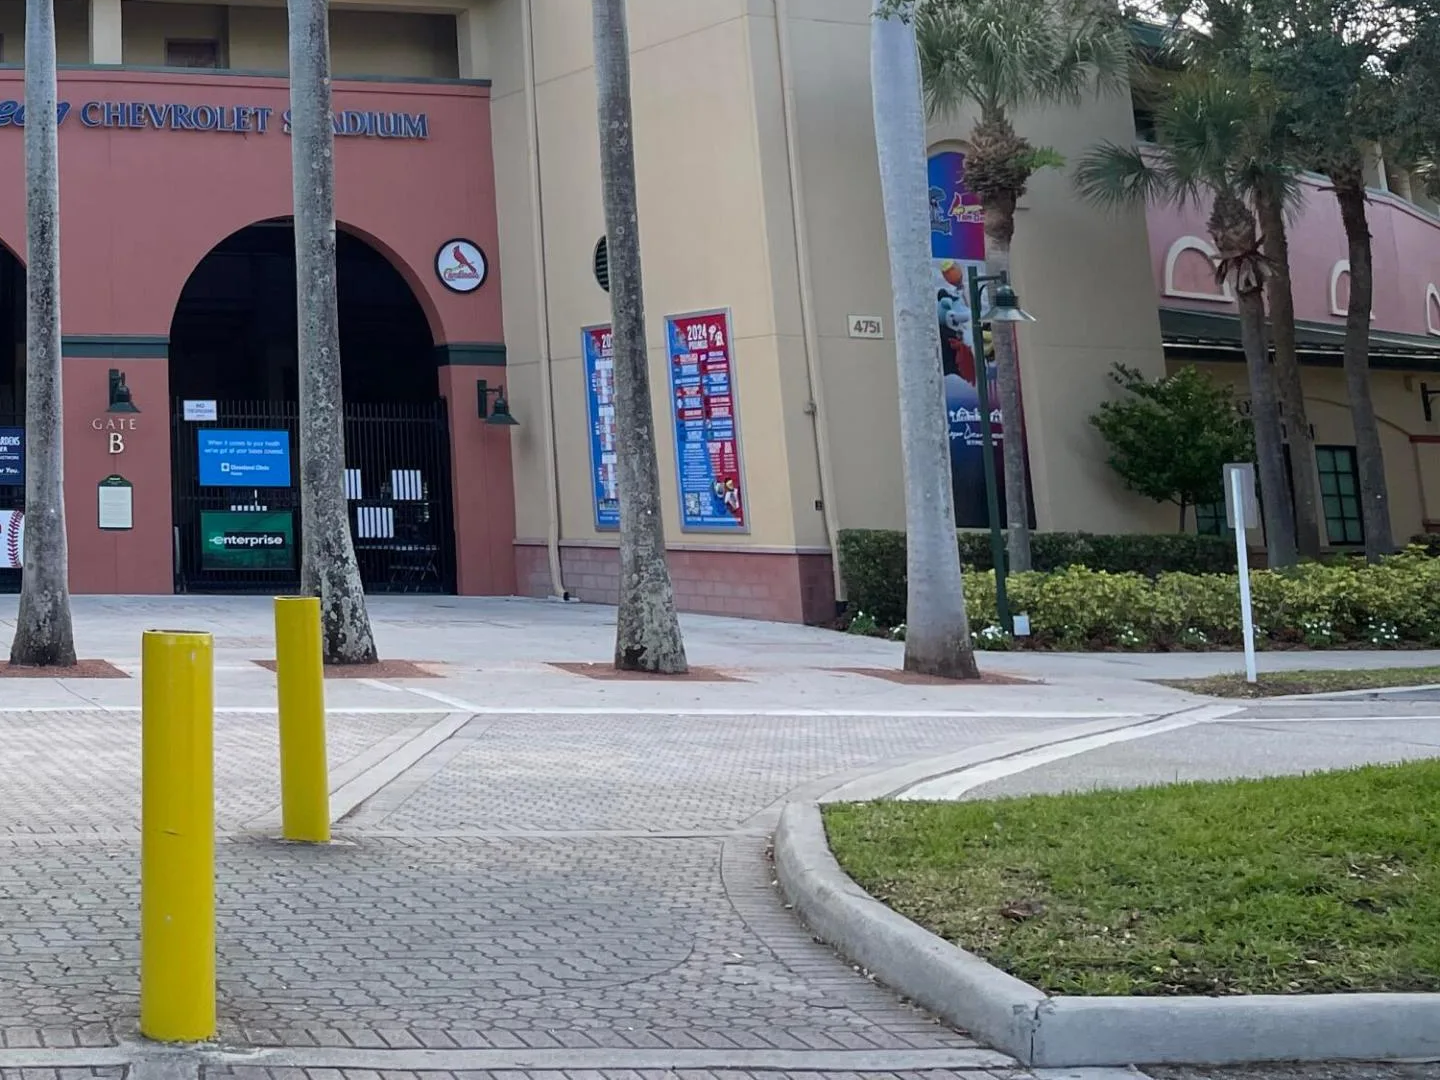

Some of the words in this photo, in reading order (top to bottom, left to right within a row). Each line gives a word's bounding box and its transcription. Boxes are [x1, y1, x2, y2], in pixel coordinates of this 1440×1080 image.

[81, 101, 273, 132] CHEVROLET
[687, 323, 708, 341] 2024
[853, 320, 880, 334] 4751
[92, 418, 137, 430] GATE
[109, 432, 125, 454] B
[209, 534, 283, 547] enterprise
